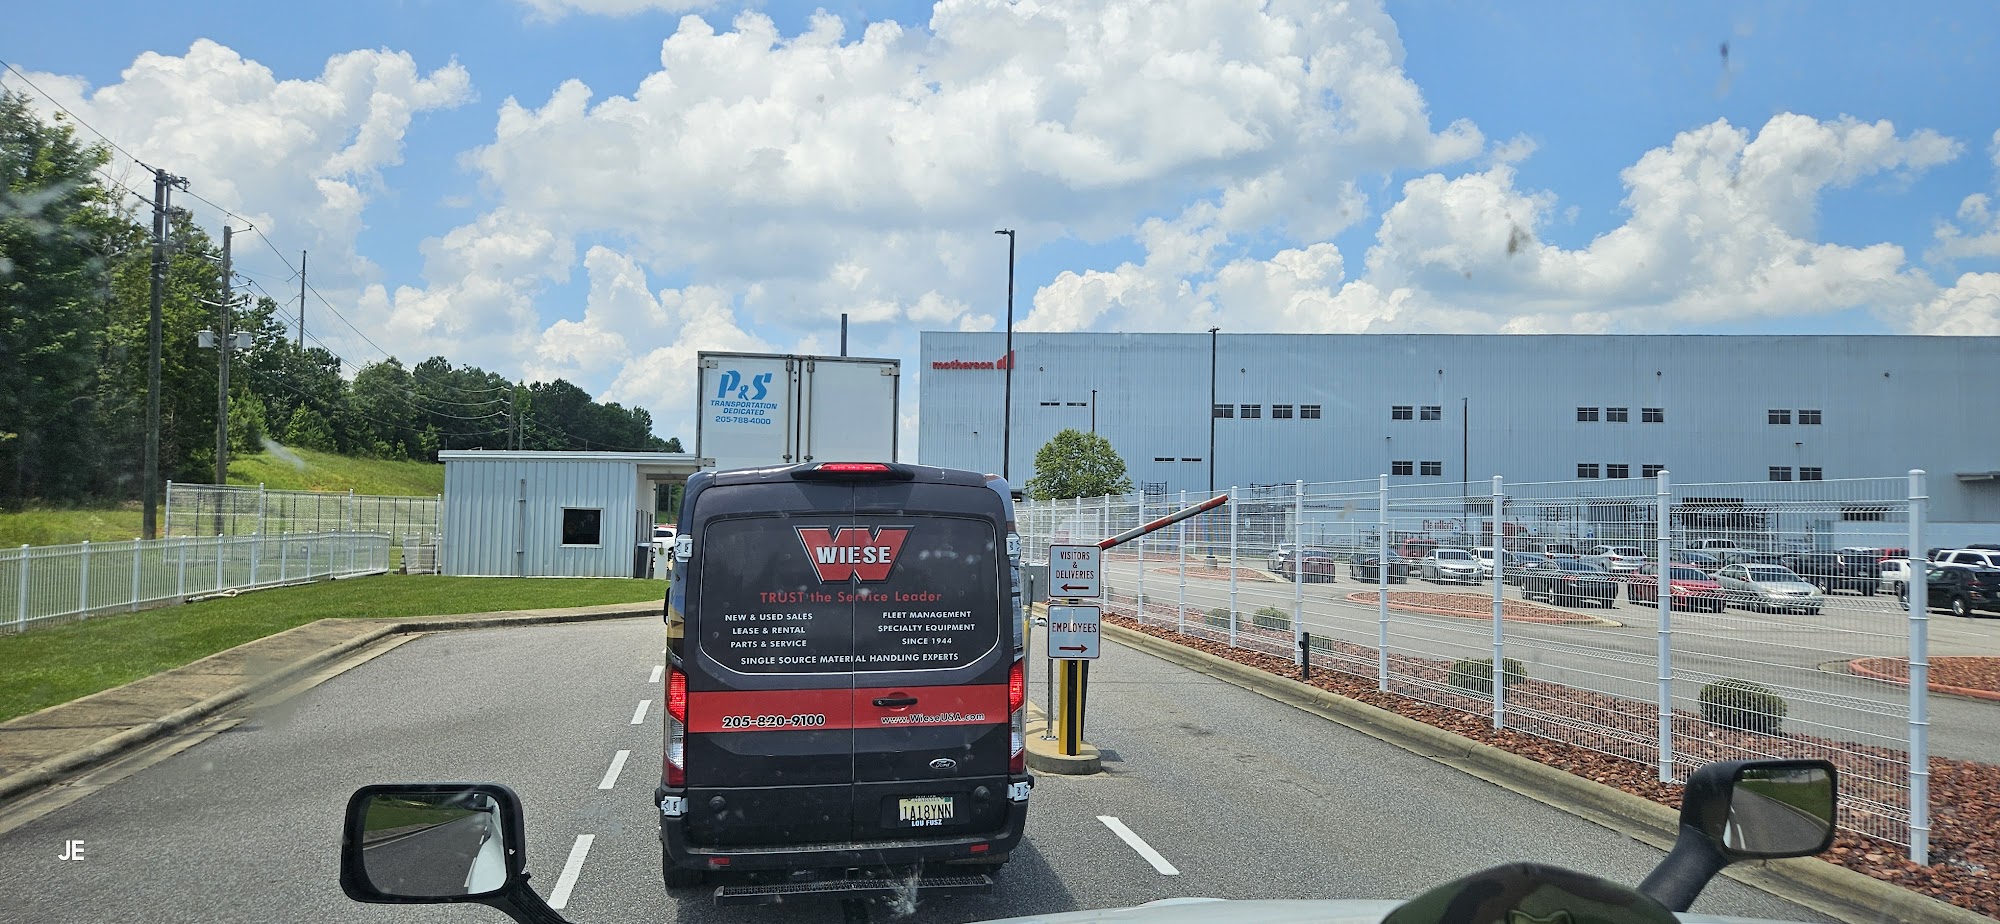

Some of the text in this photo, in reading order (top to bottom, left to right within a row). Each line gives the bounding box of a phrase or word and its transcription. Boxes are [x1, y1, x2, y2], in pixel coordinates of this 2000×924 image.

[932, 360, 995, 370] motherson
[717, 370, 773, 401] P&S
[710, 400, 778, 410] TRANSPORTATION
[723, 407, 765, 416] DEDICATED
[715, 415, 772, 425] 205-788-4000
[815, 546, 892, 565] WIESE
[1060, 551, 1090, 560] VISITORS
[1072, 561, 1078, 569] &
[1055, 569, 1095, 580] DELIVERIES
[760, 590, 942, 604] TRUST the Service Leader
[724, 612, 814, 622] NEW & USED SALES
[882, 610, 972, 619] FLEET MANAGEMENT
[732, 626, 806, 635] LEASE & RENTAL
[878, 623, 976, 632] SPECIALTY EQUIPMENT
[1051, 622, 1097, 634] EMPLOYEES
[730, 639, 807, 649] PARTS & SERVICE
[901, 637, 952, 646] SINCE 1944
[740, 652, 959, 666] SINGLE SOURCE MATERIAL HANDLING EXPERTS
[721, 714, 826, 729] 205-820-9100
[880, 712, 986, 725] www.WieseUSA.com
[903, 803, 952, 820] 1A18YNN
